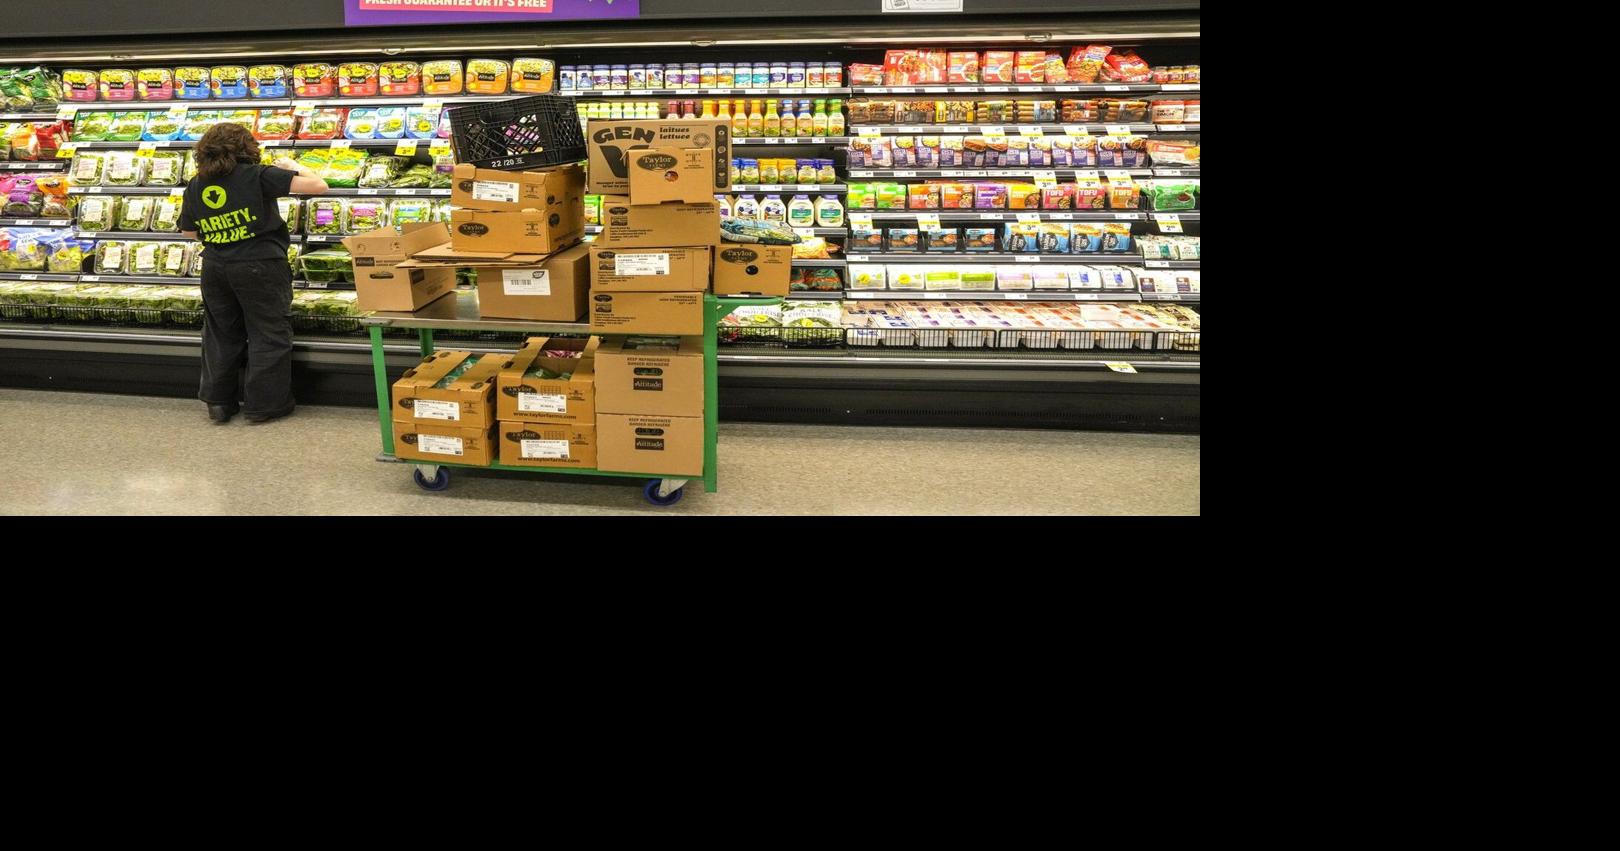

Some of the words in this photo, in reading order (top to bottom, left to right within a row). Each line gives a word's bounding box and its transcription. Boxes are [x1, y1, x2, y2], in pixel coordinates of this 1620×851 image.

[517, 0, 547, 8] FREE
[593, 126, 656, 144] GEN
[642, 156, 672, 165] Taylor
[727, 250, 753, 258] Taylor
